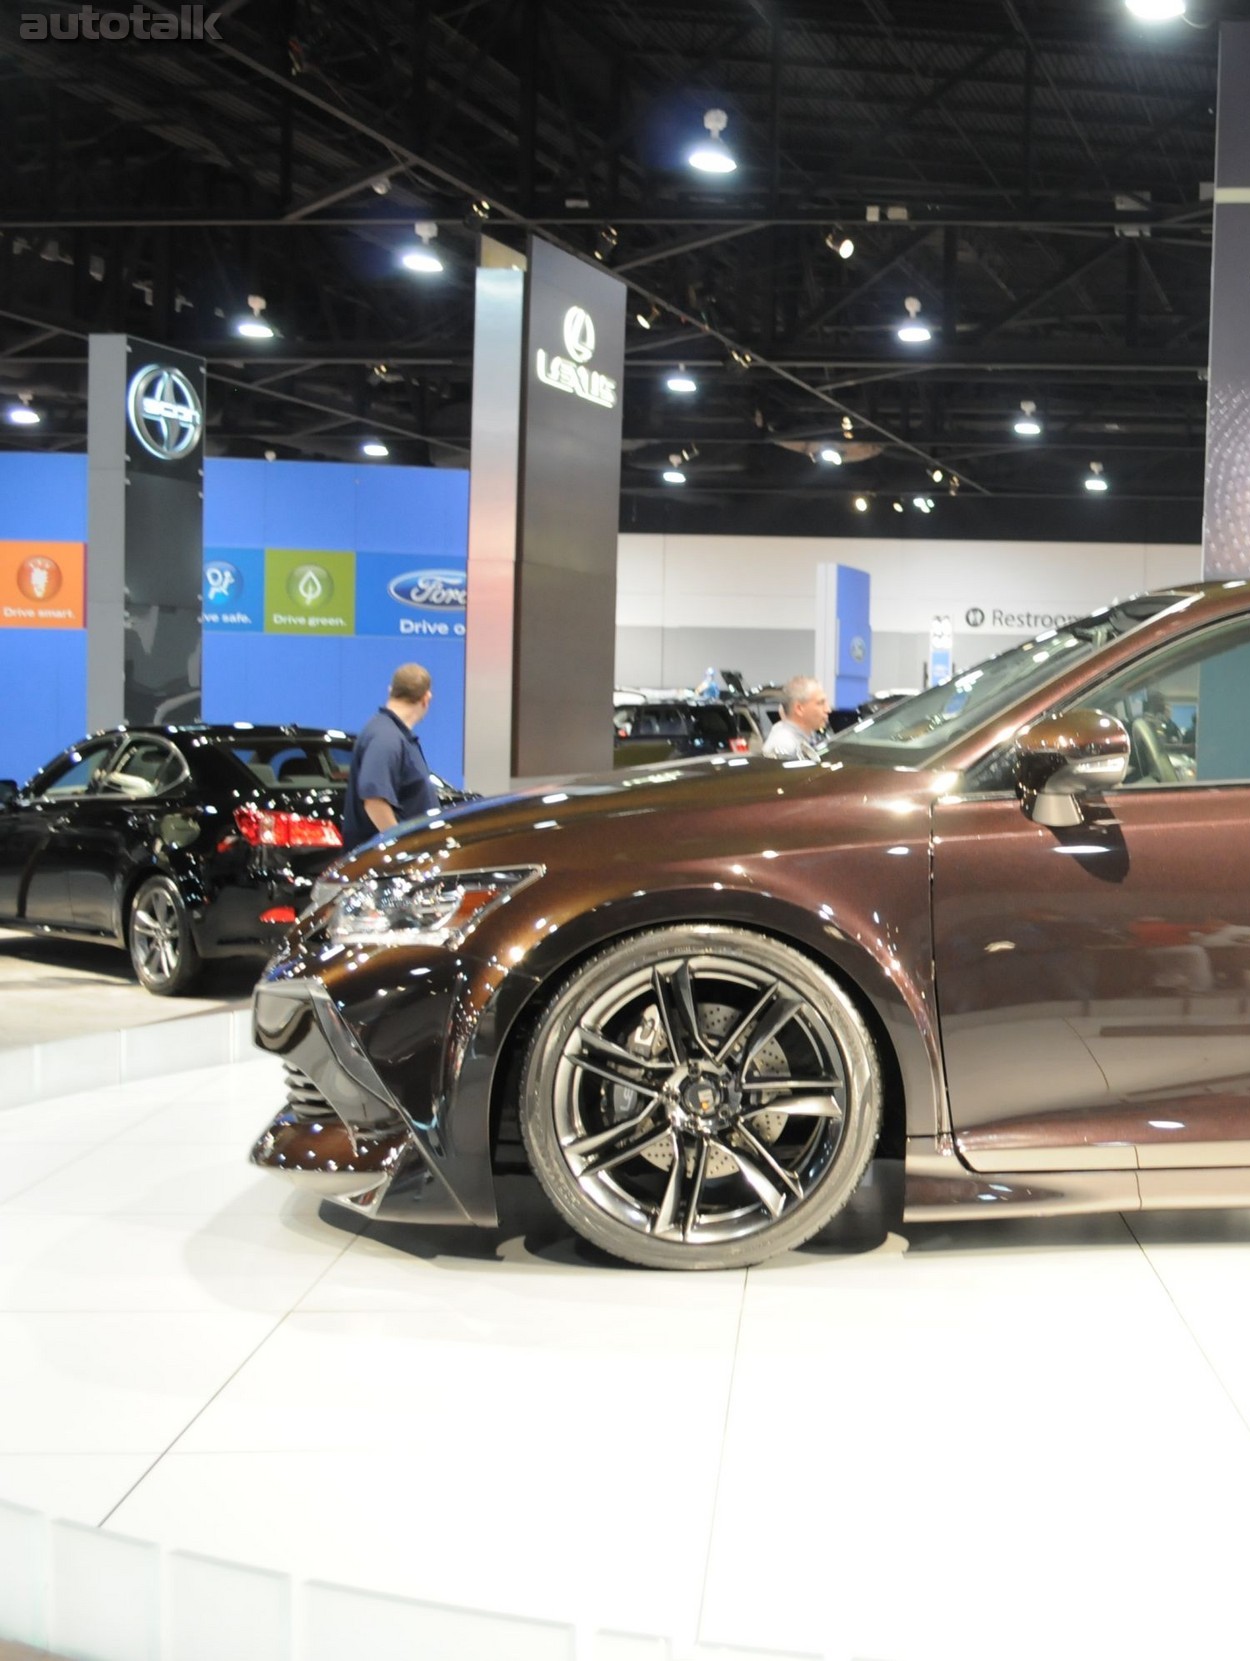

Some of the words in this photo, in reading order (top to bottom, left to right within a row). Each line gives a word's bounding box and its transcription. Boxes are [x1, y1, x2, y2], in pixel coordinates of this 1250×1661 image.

[536, 348, 617, 408] LEXUS
[3, 605, 36, 618] Drive
[38, 607, 76, 620] smart.
[222, 612, 252, 624] safe.
[273, 613, 307, 626] Drive
[308, 616, 347, 628] green.
[400, 618, 449, 635] Drive
